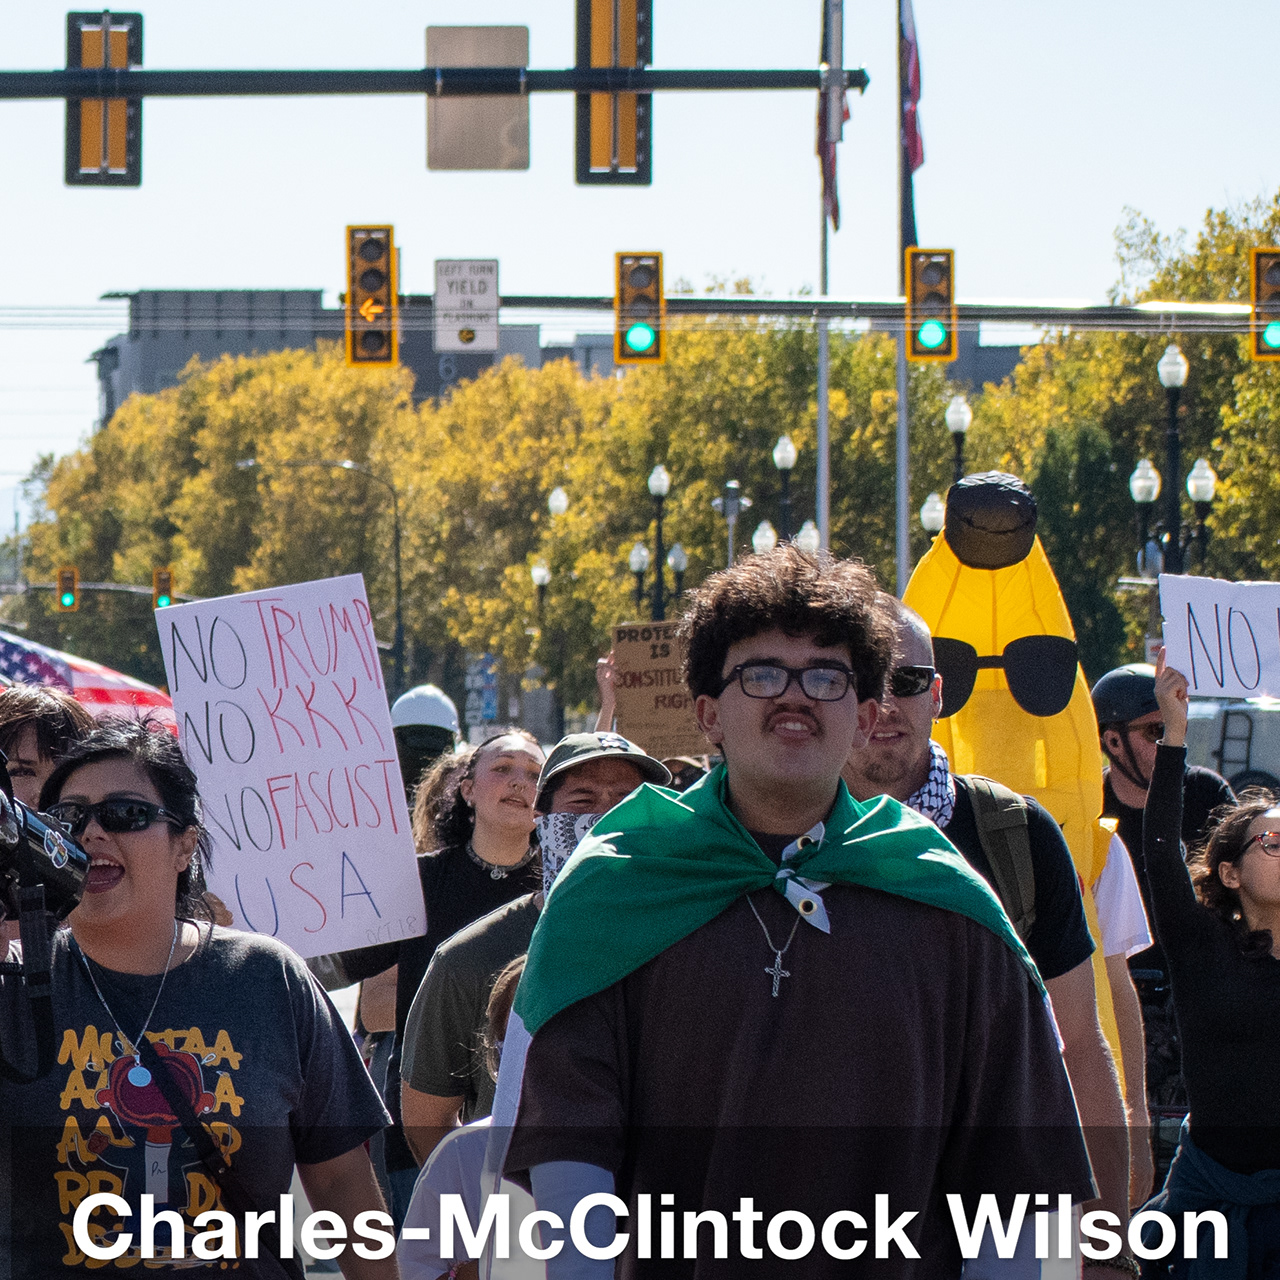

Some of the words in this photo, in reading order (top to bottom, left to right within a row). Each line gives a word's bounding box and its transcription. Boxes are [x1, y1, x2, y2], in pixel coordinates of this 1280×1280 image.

[446, 280, 489, 295] YIELD
[171, 615, 248, 693] NO
[240, 598, 382, 690] TRUMP
[616, 626, 675, 643] PROTE
[650, 642, 671, 659] IS
[1186, 602, 1261, 690] NO
[185, 700, 256, 765] NO
[257, 676, 386, 753] KKK
[205, 786, 273, 852] NO
[266, 759, 399, 850] FASCIST
[234, 851, 382, 938] USA
